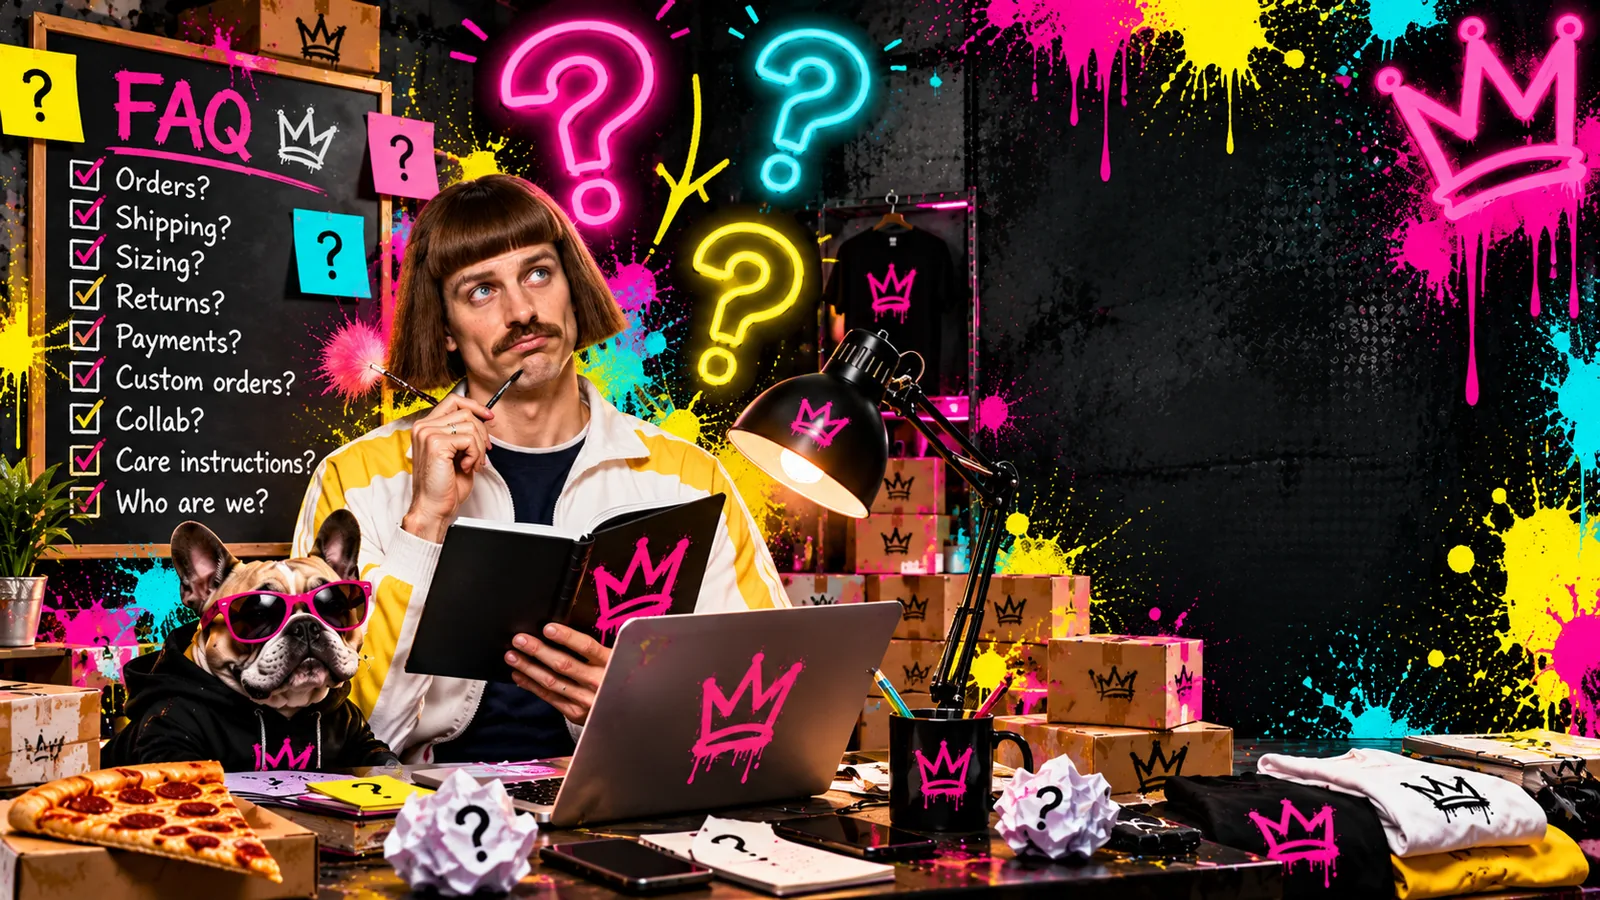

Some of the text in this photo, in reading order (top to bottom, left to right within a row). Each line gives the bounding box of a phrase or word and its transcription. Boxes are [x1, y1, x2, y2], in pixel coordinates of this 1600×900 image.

[22, 68, 52, 123] ?
[112, 69, 253, 162] FAQ
[754, 27, 872, 194] ?
[502, 19, 656, 226] ?
[390, 134, 414, 182] ?
[115, 166, 211, 199] Orders?
[115, 204, 232, 247] Shipping?
[115, 244, 206, 282] Sizing?
[316, 230, 343, 280] ?
[116, 282, 226, 315] Returns?
[691, 221, 805, 386] ?
[116, 324, 242, 358] Payments?
[115, 364, 296, 396] Custom orders?
[115, 406, 205, 433] Collab?
[115, 447, 316, 475] Care instructions?
[116, 488, 269, 515] Who are we?
[1036, 785, 1063, 831] ?
[455, 804, 490, 863] ?
